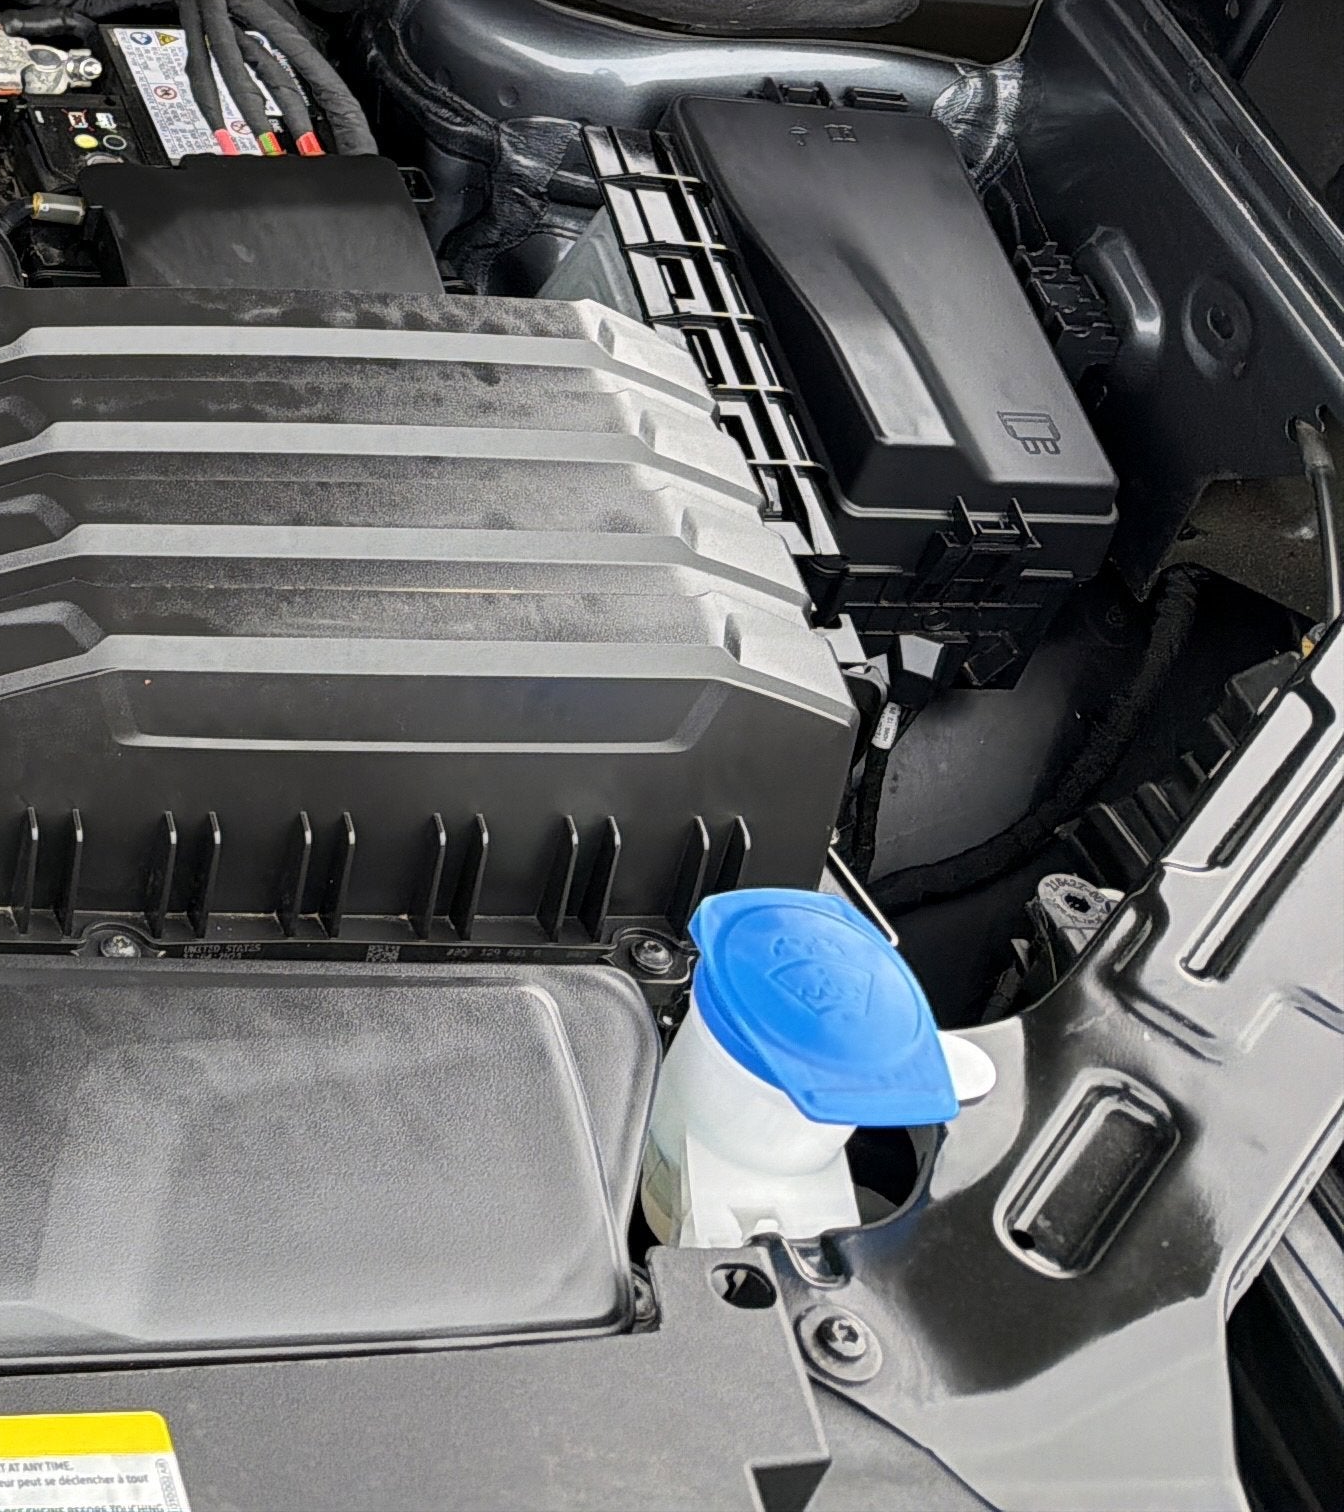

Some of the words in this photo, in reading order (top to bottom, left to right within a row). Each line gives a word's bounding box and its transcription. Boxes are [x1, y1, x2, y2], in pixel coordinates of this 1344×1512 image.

[8, 1463, 21, 1472] AT
[22, 1461, 43, 1472] ANY
[46, 1460, 74, 1471] TIME.
[16, 1477, 42, 1489] peut
[44, 1478, 56, 1486] se
[125, 1473, 149, 1484] tout
